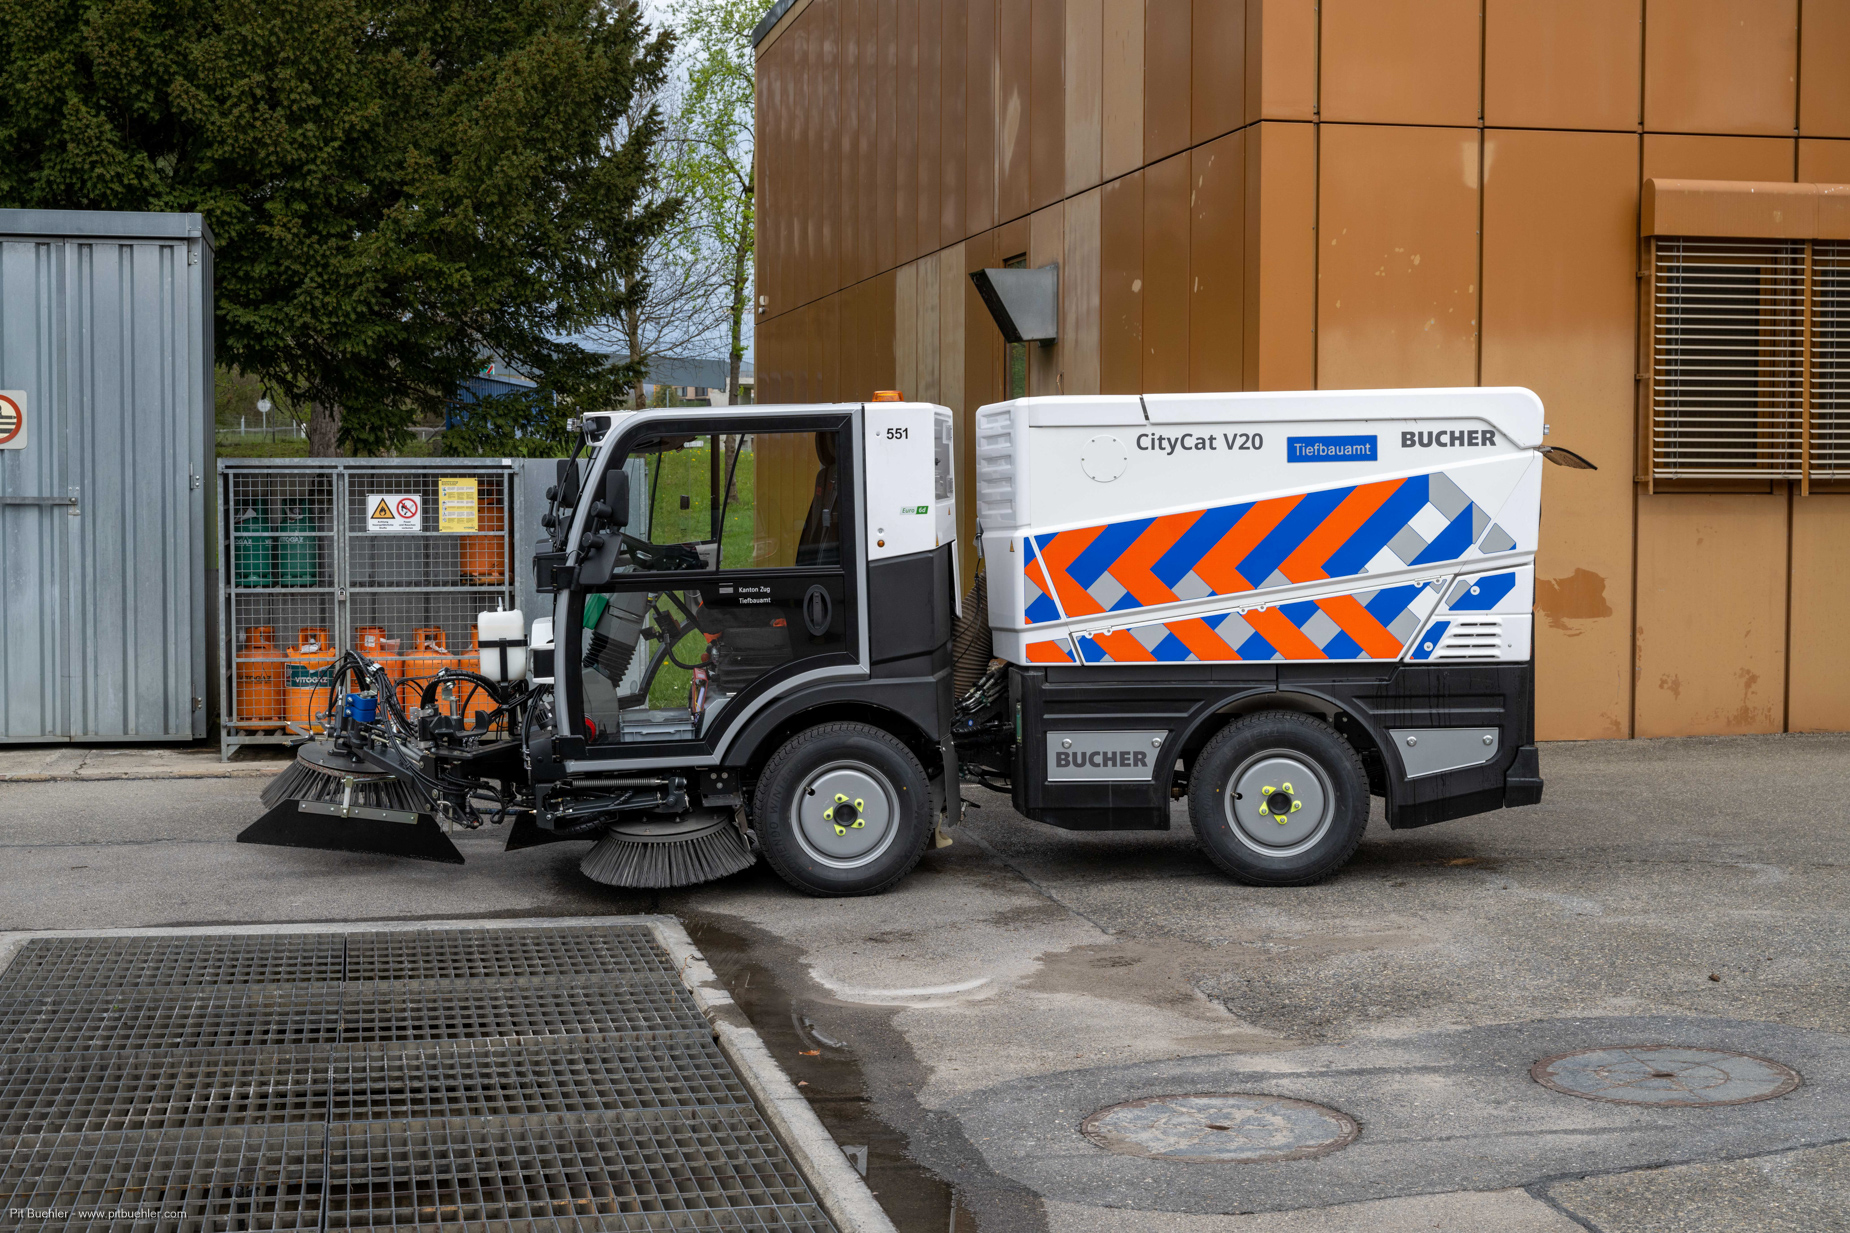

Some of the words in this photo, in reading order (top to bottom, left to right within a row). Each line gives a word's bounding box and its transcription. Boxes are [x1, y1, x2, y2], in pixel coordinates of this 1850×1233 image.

[886, 427, 908, 440] 551
[1401, 429, 1497, 448] BUCHER
[1136, 432, 1217, 456] CityCat
[1223, 432, 1264, 450] V20
[1293, 442, 1371, 456] Tiefbauamt
[760, 586, 771, 594] Zug
[1055, 751, 1149, 768] BUCHER
